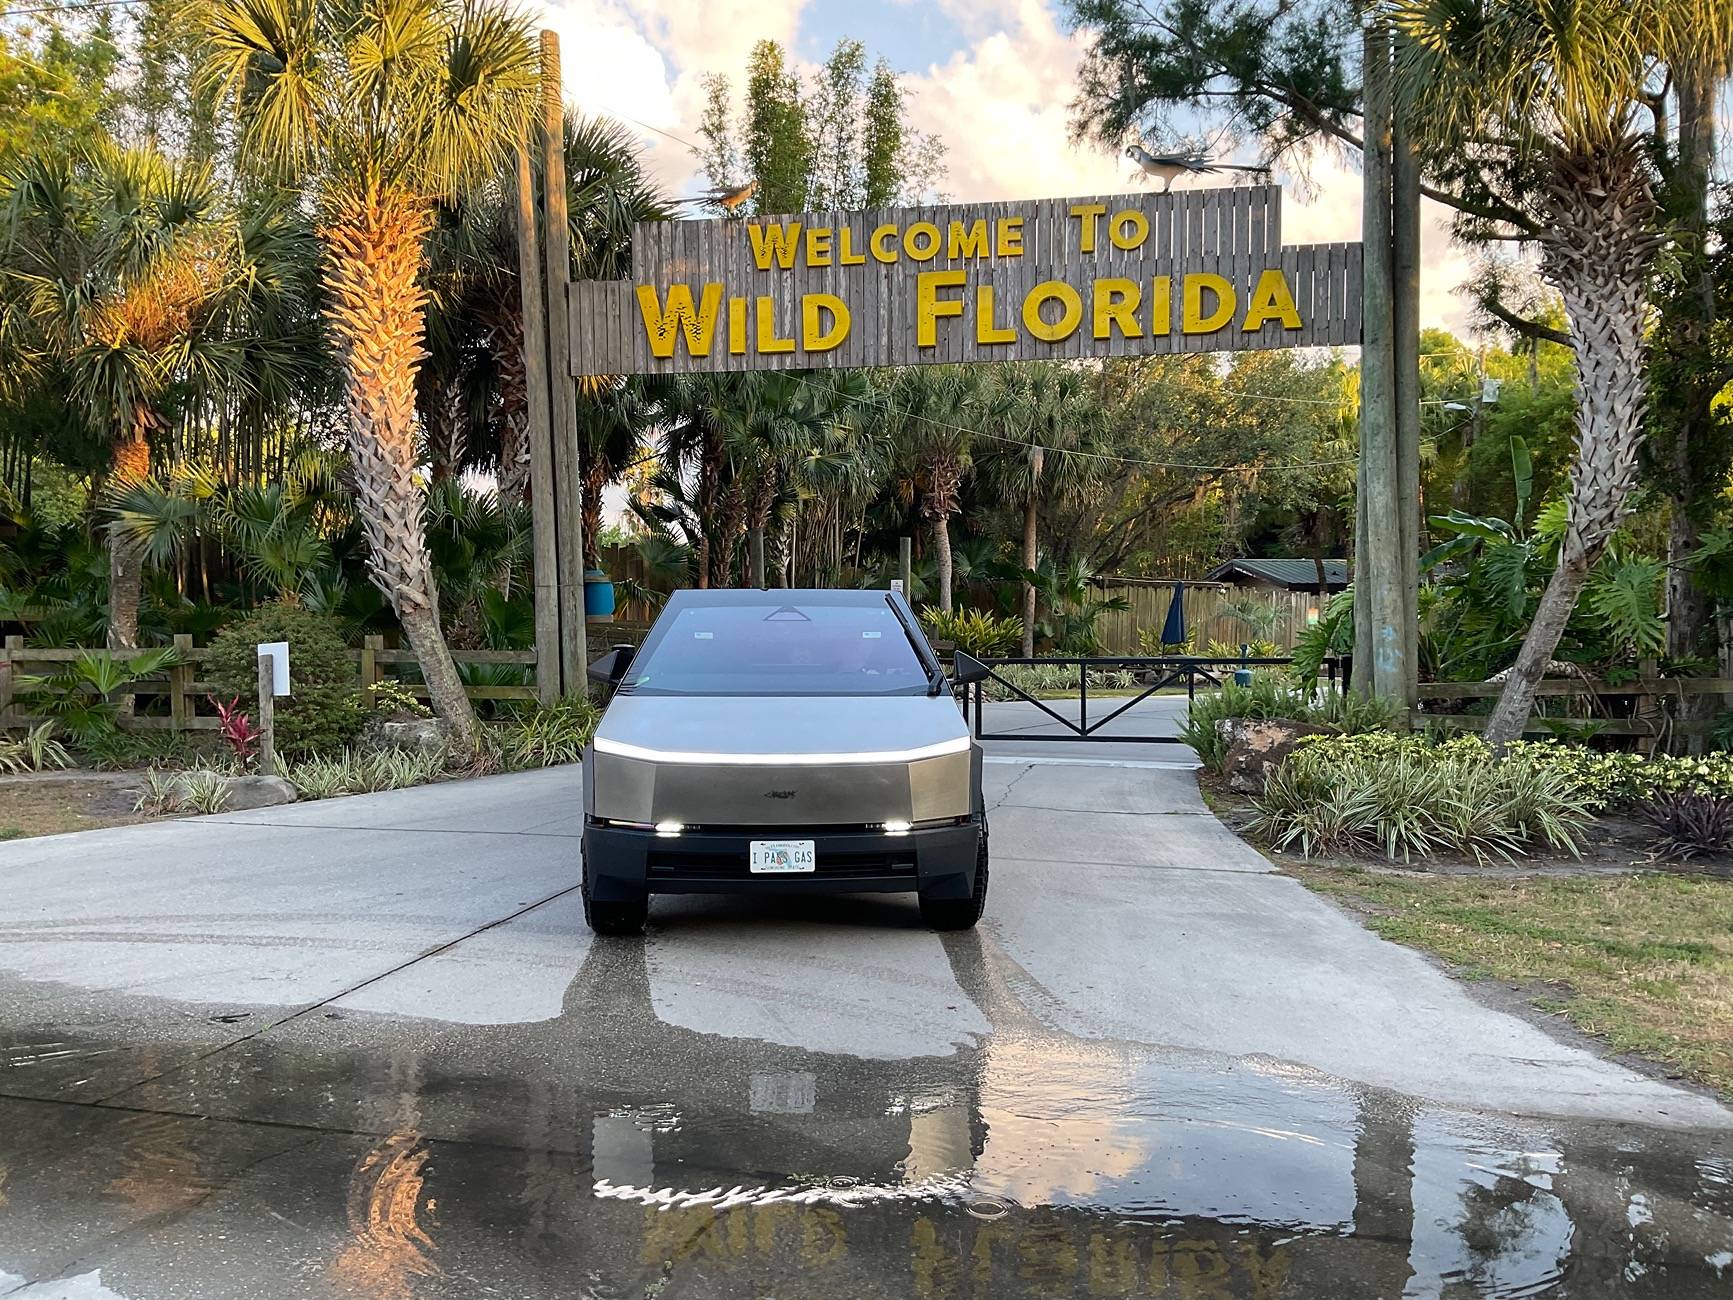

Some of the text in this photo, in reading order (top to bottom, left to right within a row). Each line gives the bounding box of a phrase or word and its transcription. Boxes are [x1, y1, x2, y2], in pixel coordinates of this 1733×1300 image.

[747, 204, 1150, 270] WELCOME TO
[636, 269, 1304, 358] WILD FLORIDA
[752, 852, 758, 864] I
[794, 850, 813, 863] GAS
